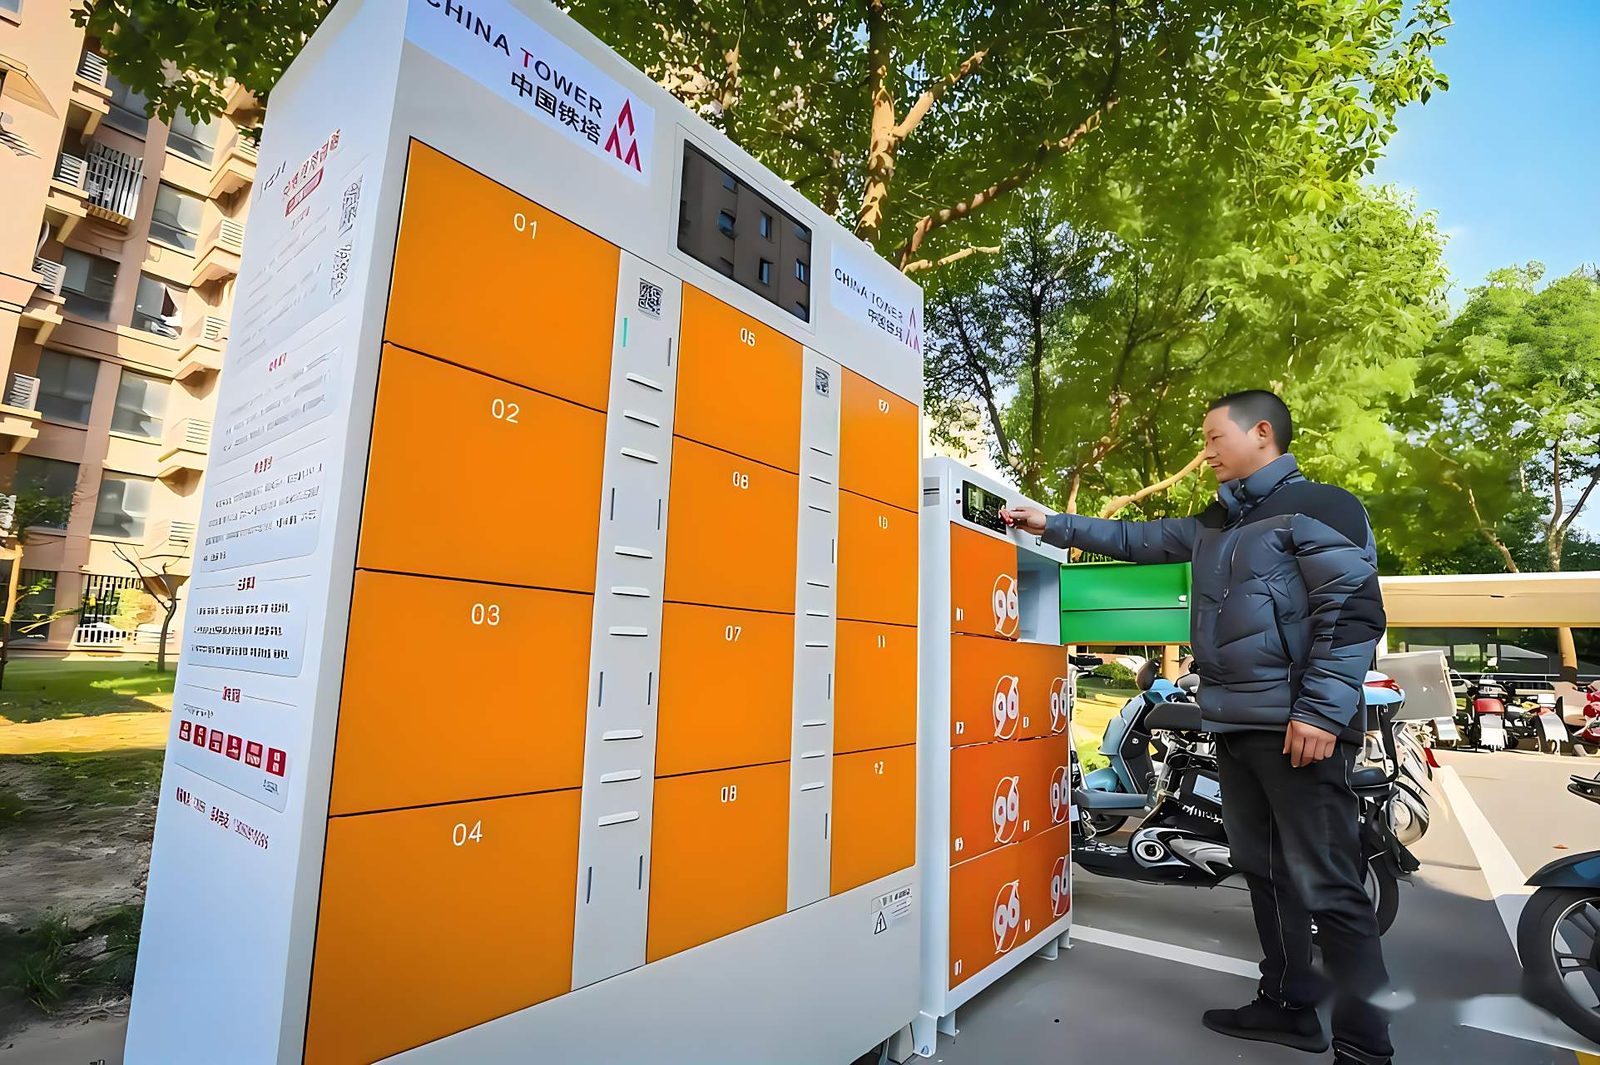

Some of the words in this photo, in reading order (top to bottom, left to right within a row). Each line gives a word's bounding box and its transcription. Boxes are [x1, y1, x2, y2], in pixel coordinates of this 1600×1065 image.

[520, 47, 602, 118] TOWER
[511, 71, 601, 145] 中国铁塔
[513, 212, 537, 240] 01
[491, 399, 520, 423] 02
[471, 602, 500, 626] 03
[725, 625, 742, 642] 07
[452, 820, 483, 847] 04
